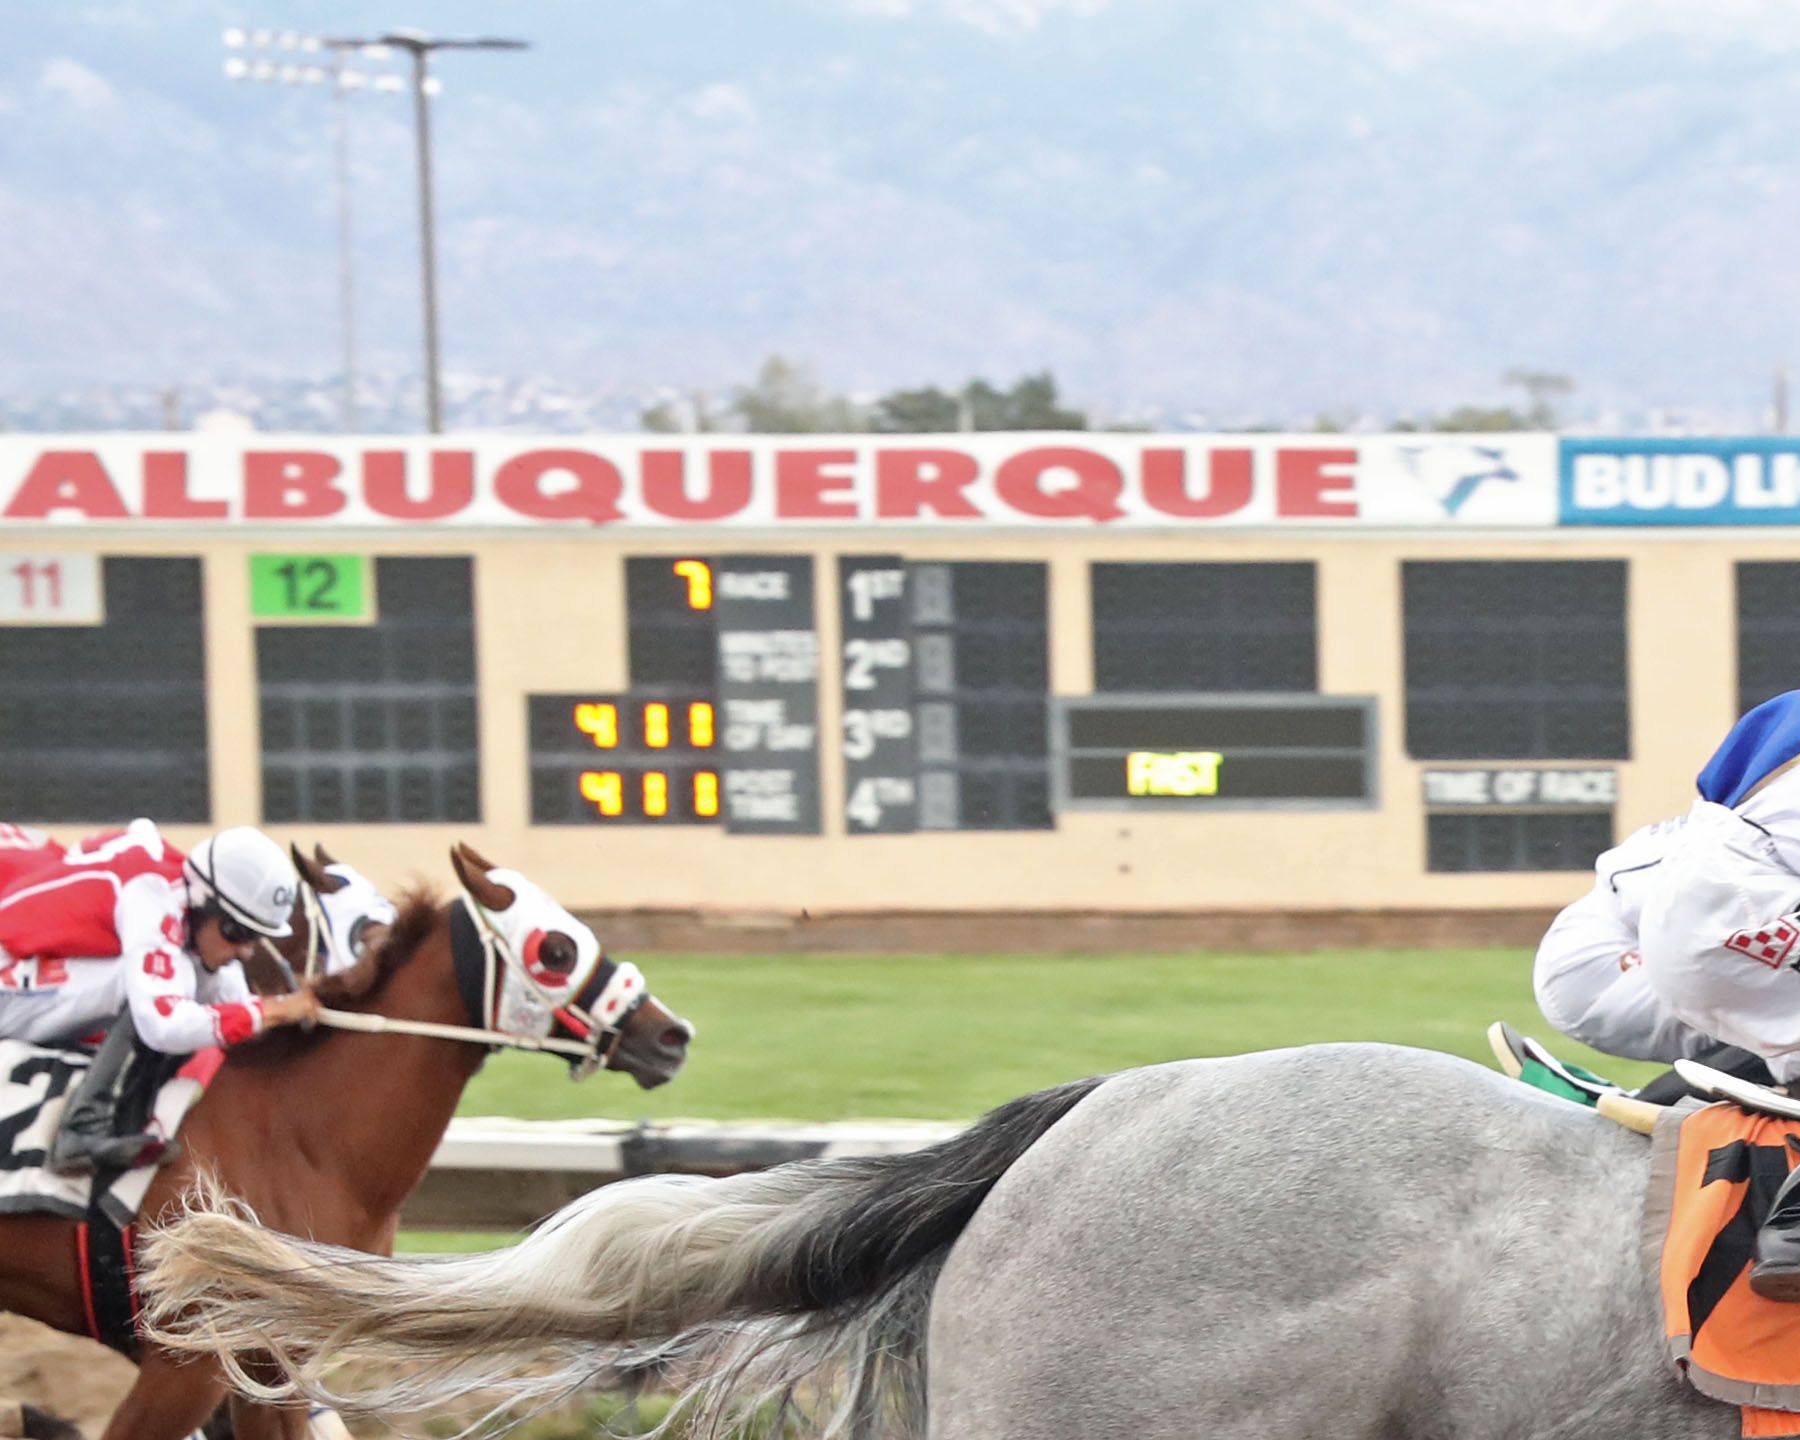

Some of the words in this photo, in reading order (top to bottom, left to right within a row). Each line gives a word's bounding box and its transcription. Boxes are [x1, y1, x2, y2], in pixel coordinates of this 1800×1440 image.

[2, 447, 1358, 526] ALBUQUERQUE
[1573, 454, 1730, 510] BUD
[12, 562, 62, 607] 11
[273, 560, 338, 609] 12
[672, 560, 712, 610] 7
